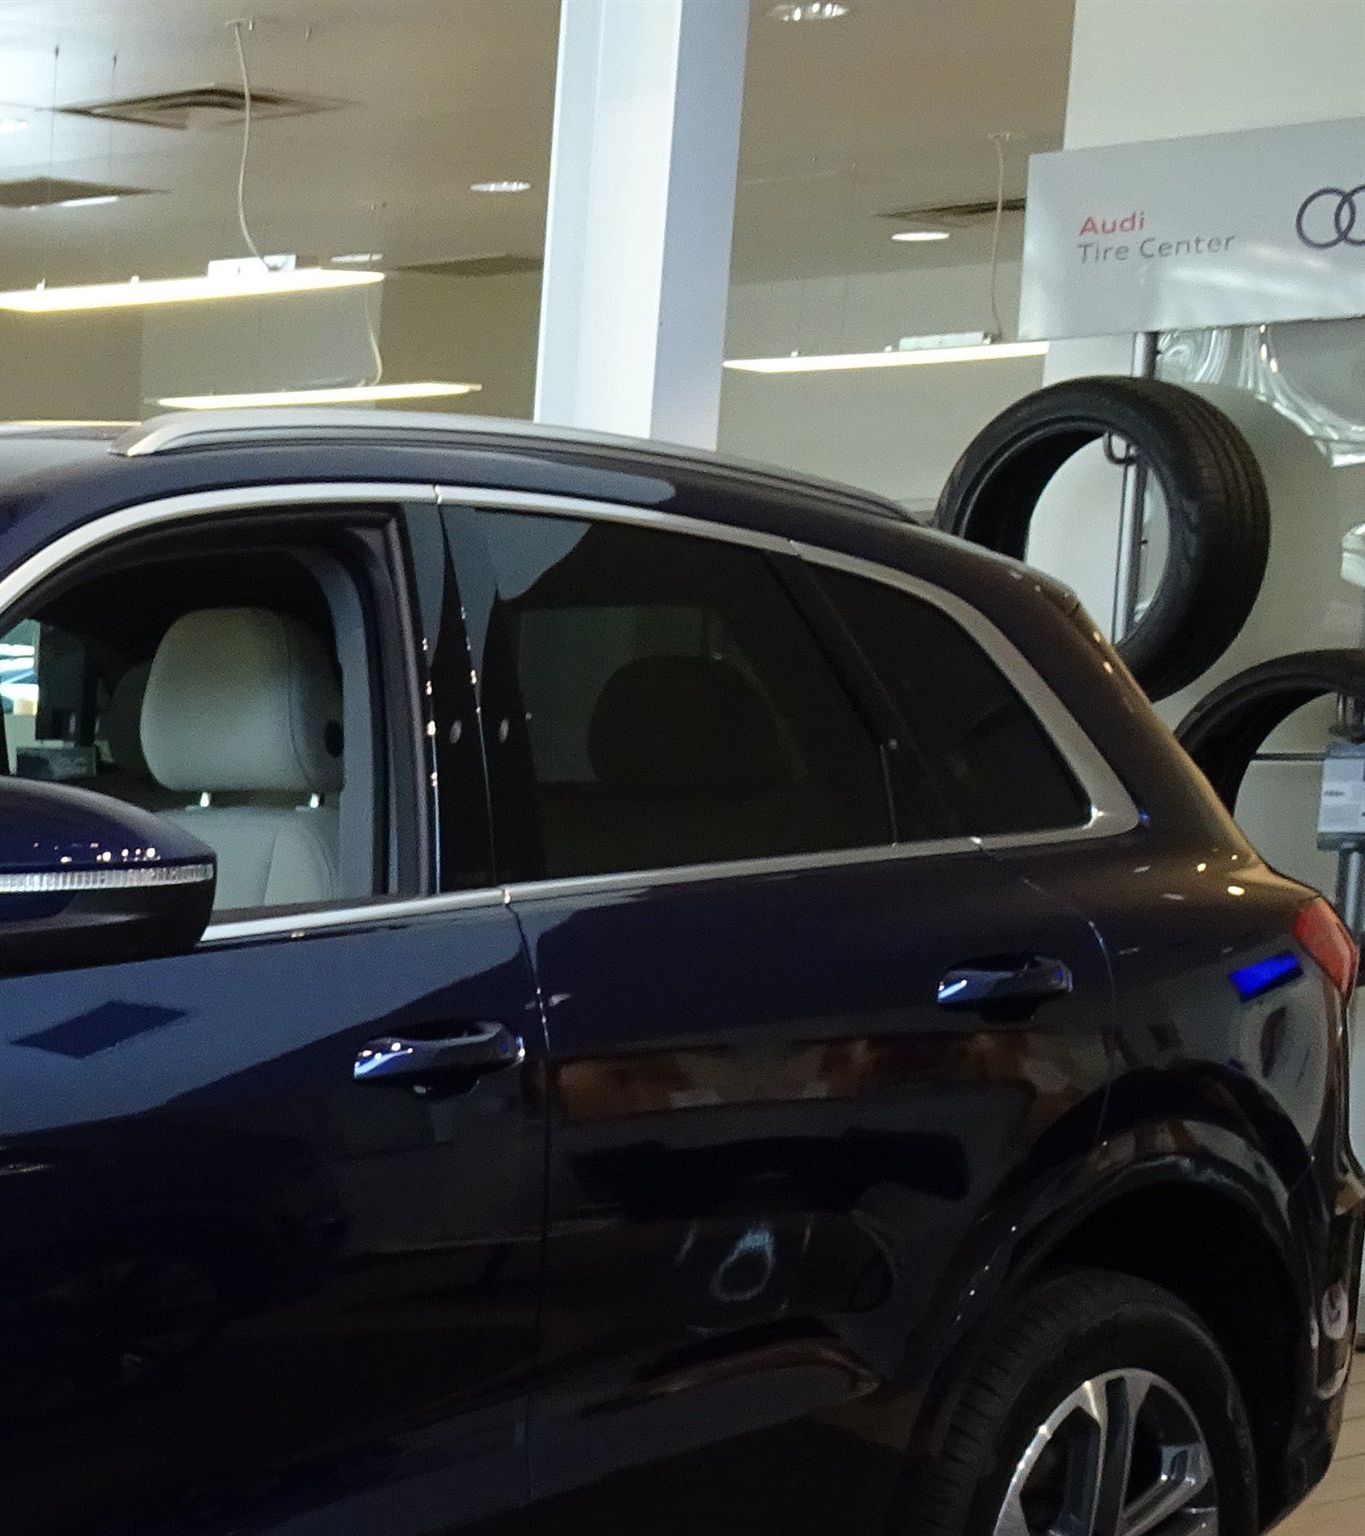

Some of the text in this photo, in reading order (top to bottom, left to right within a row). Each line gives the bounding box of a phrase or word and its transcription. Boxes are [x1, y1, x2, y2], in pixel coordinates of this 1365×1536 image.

[1079, 211, 1146, 236] Audi
[1077, 235, 1236, 264] Tire Center
